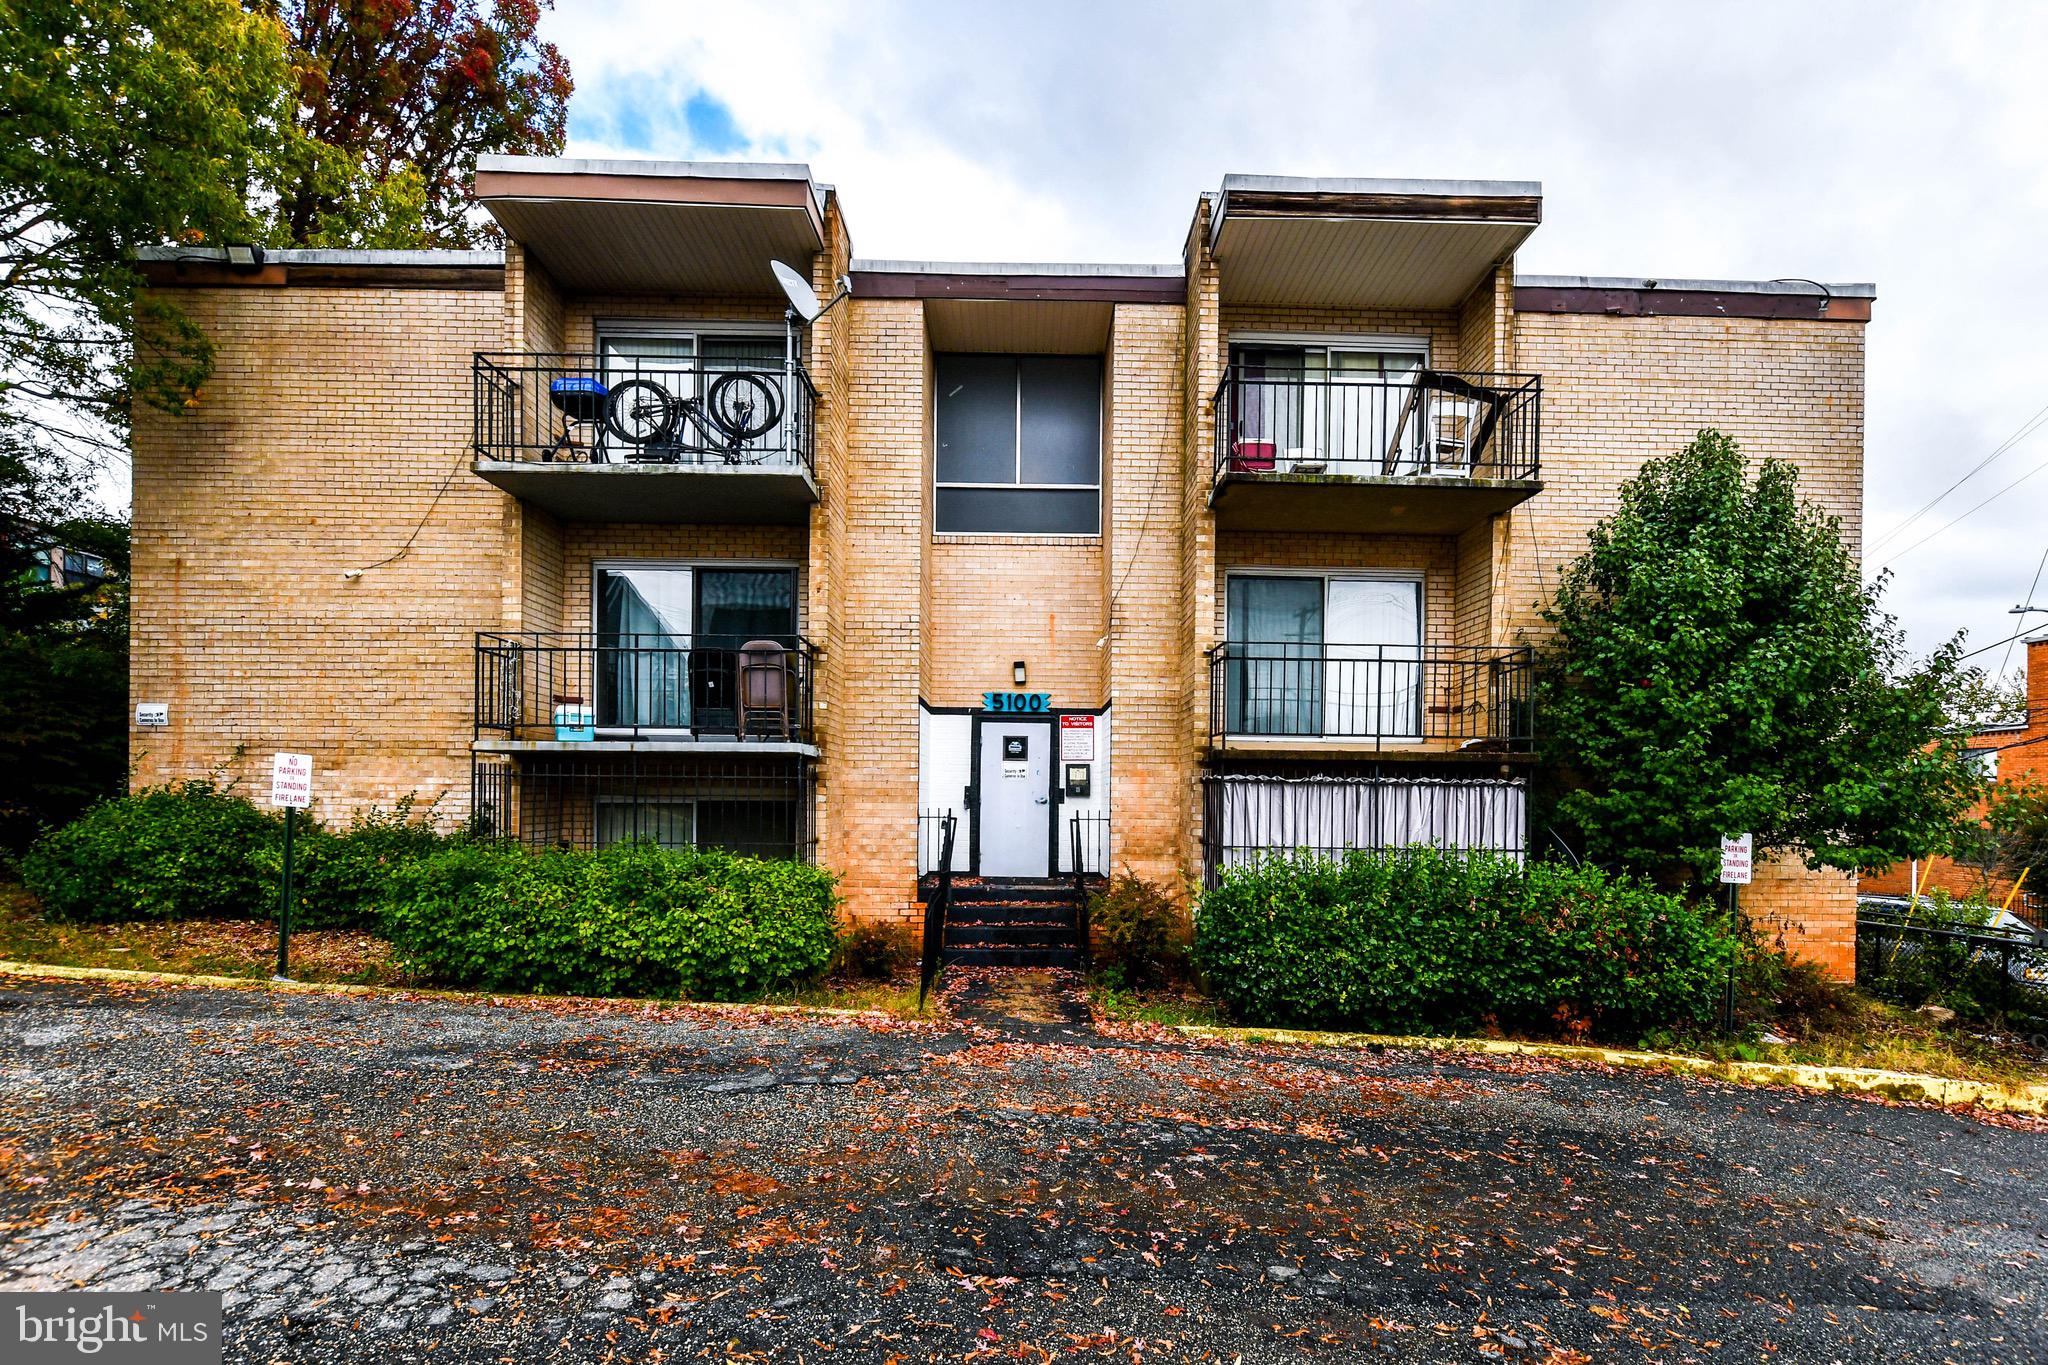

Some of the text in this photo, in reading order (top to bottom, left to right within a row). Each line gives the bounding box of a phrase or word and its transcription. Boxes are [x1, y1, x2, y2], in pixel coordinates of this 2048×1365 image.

[992, 693, 1042, 711] 5100
[289, 758, 298, 766] NO
[279, 767, 307, 776] PARKING
[276, 781, 307, 791] STANDING
[1724, 845, 1748, 854] PARKING
[1723, 859, 1748, 868] STANDING
